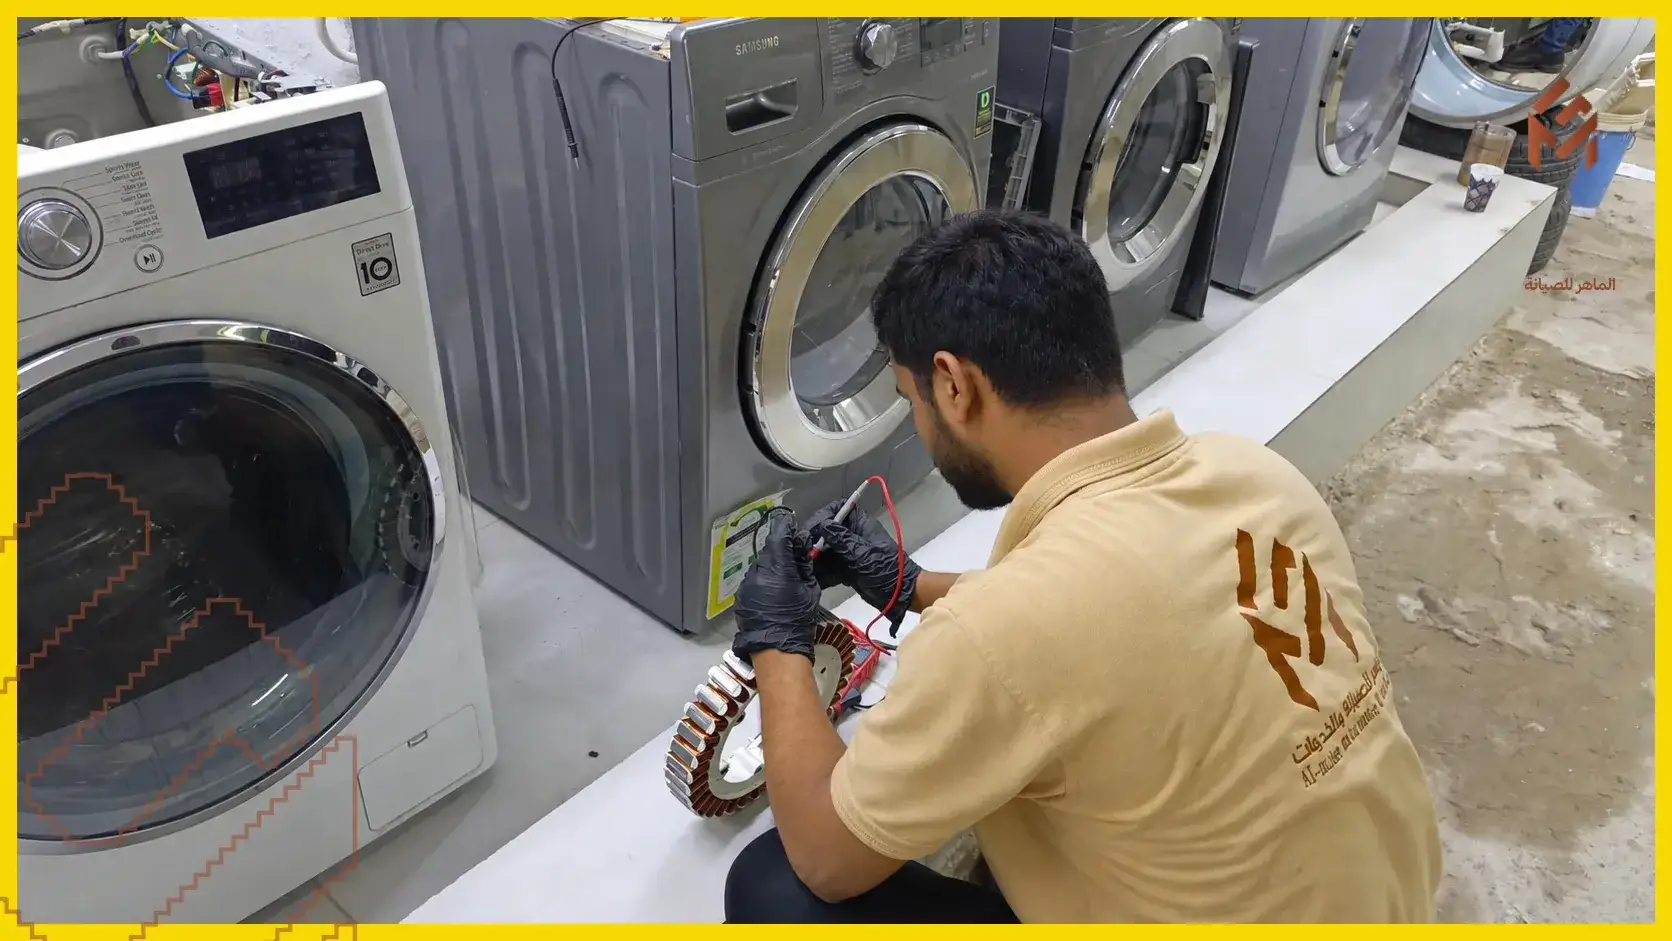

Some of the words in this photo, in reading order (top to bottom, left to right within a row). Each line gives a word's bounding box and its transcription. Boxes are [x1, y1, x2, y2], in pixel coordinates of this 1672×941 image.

[735, 35, 779, 55] SAMSUNG
[981, 92, 990, 108] D
[361, 256, 392, 284] 10
